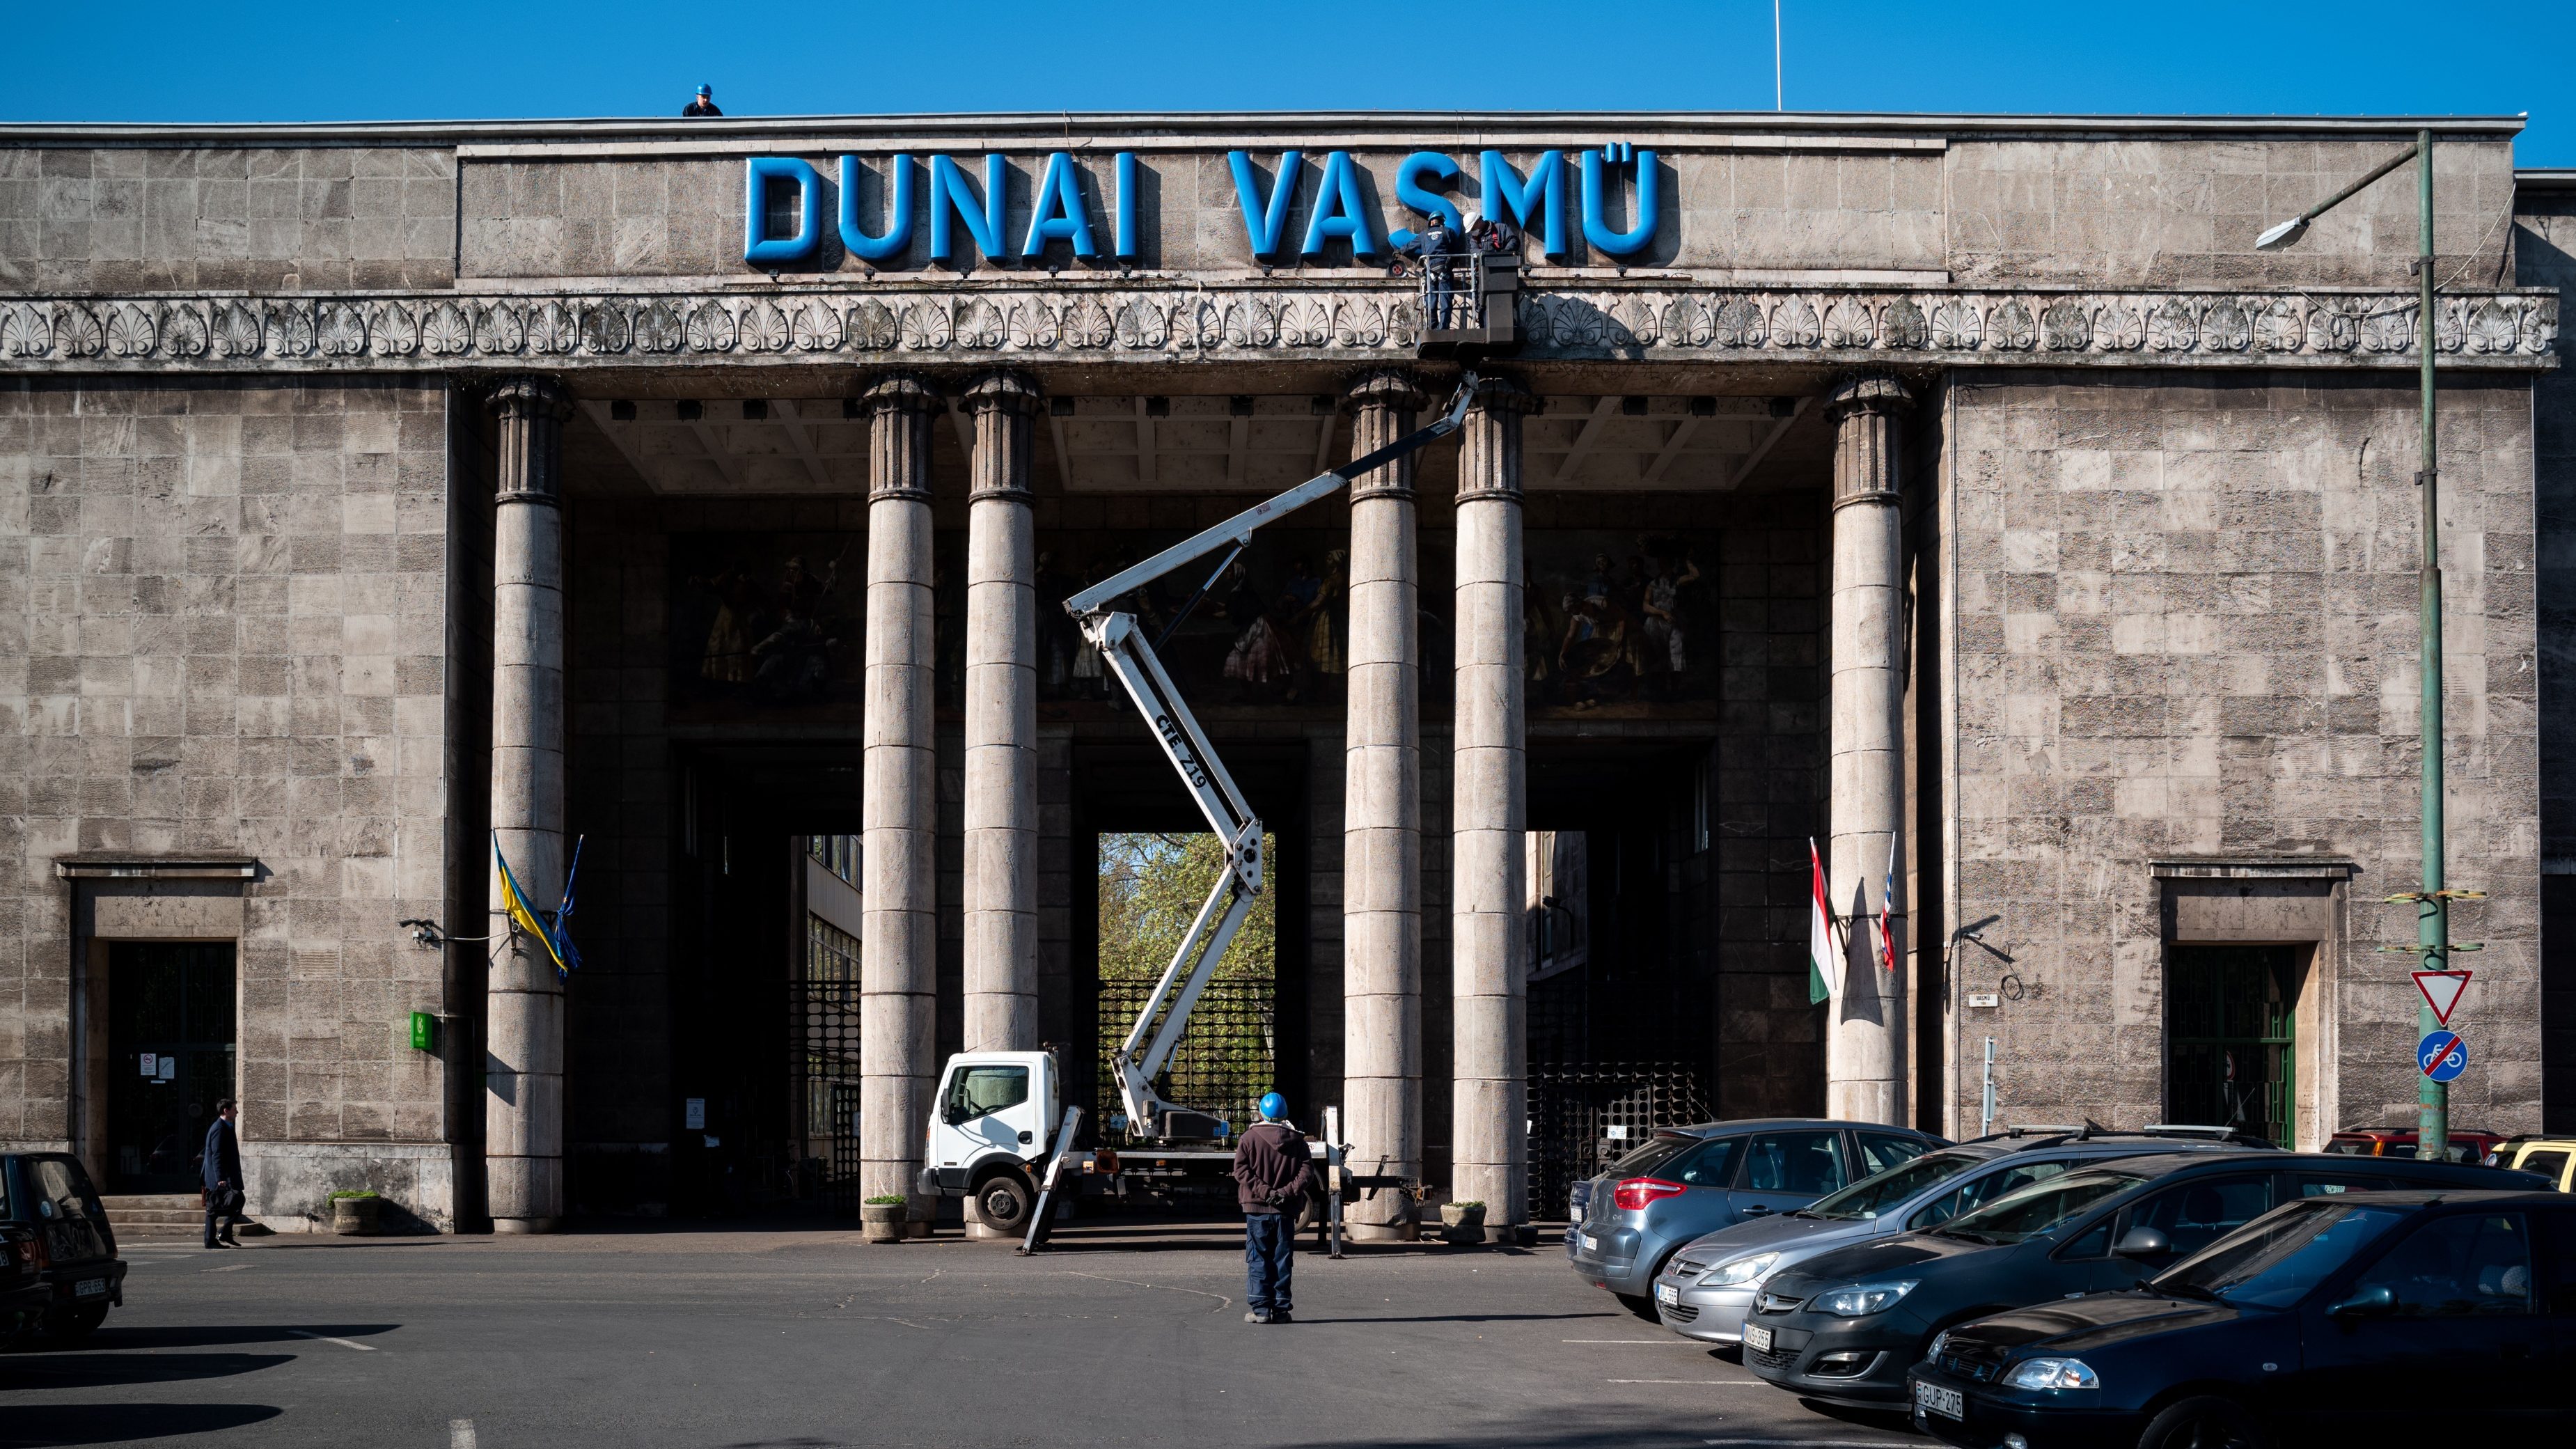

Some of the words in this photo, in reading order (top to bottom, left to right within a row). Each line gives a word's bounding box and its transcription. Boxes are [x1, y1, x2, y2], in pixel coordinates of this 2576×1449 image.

[744, 152, 1136, 263] DUNAI
[1180, 754, 1207, 788] Z19
[79, 1279, 104, 1294] GPR-653
[1745, 1324, 1769, 1348] MNS-355
[1924, 1385, 1961, 1414] GUP-275
